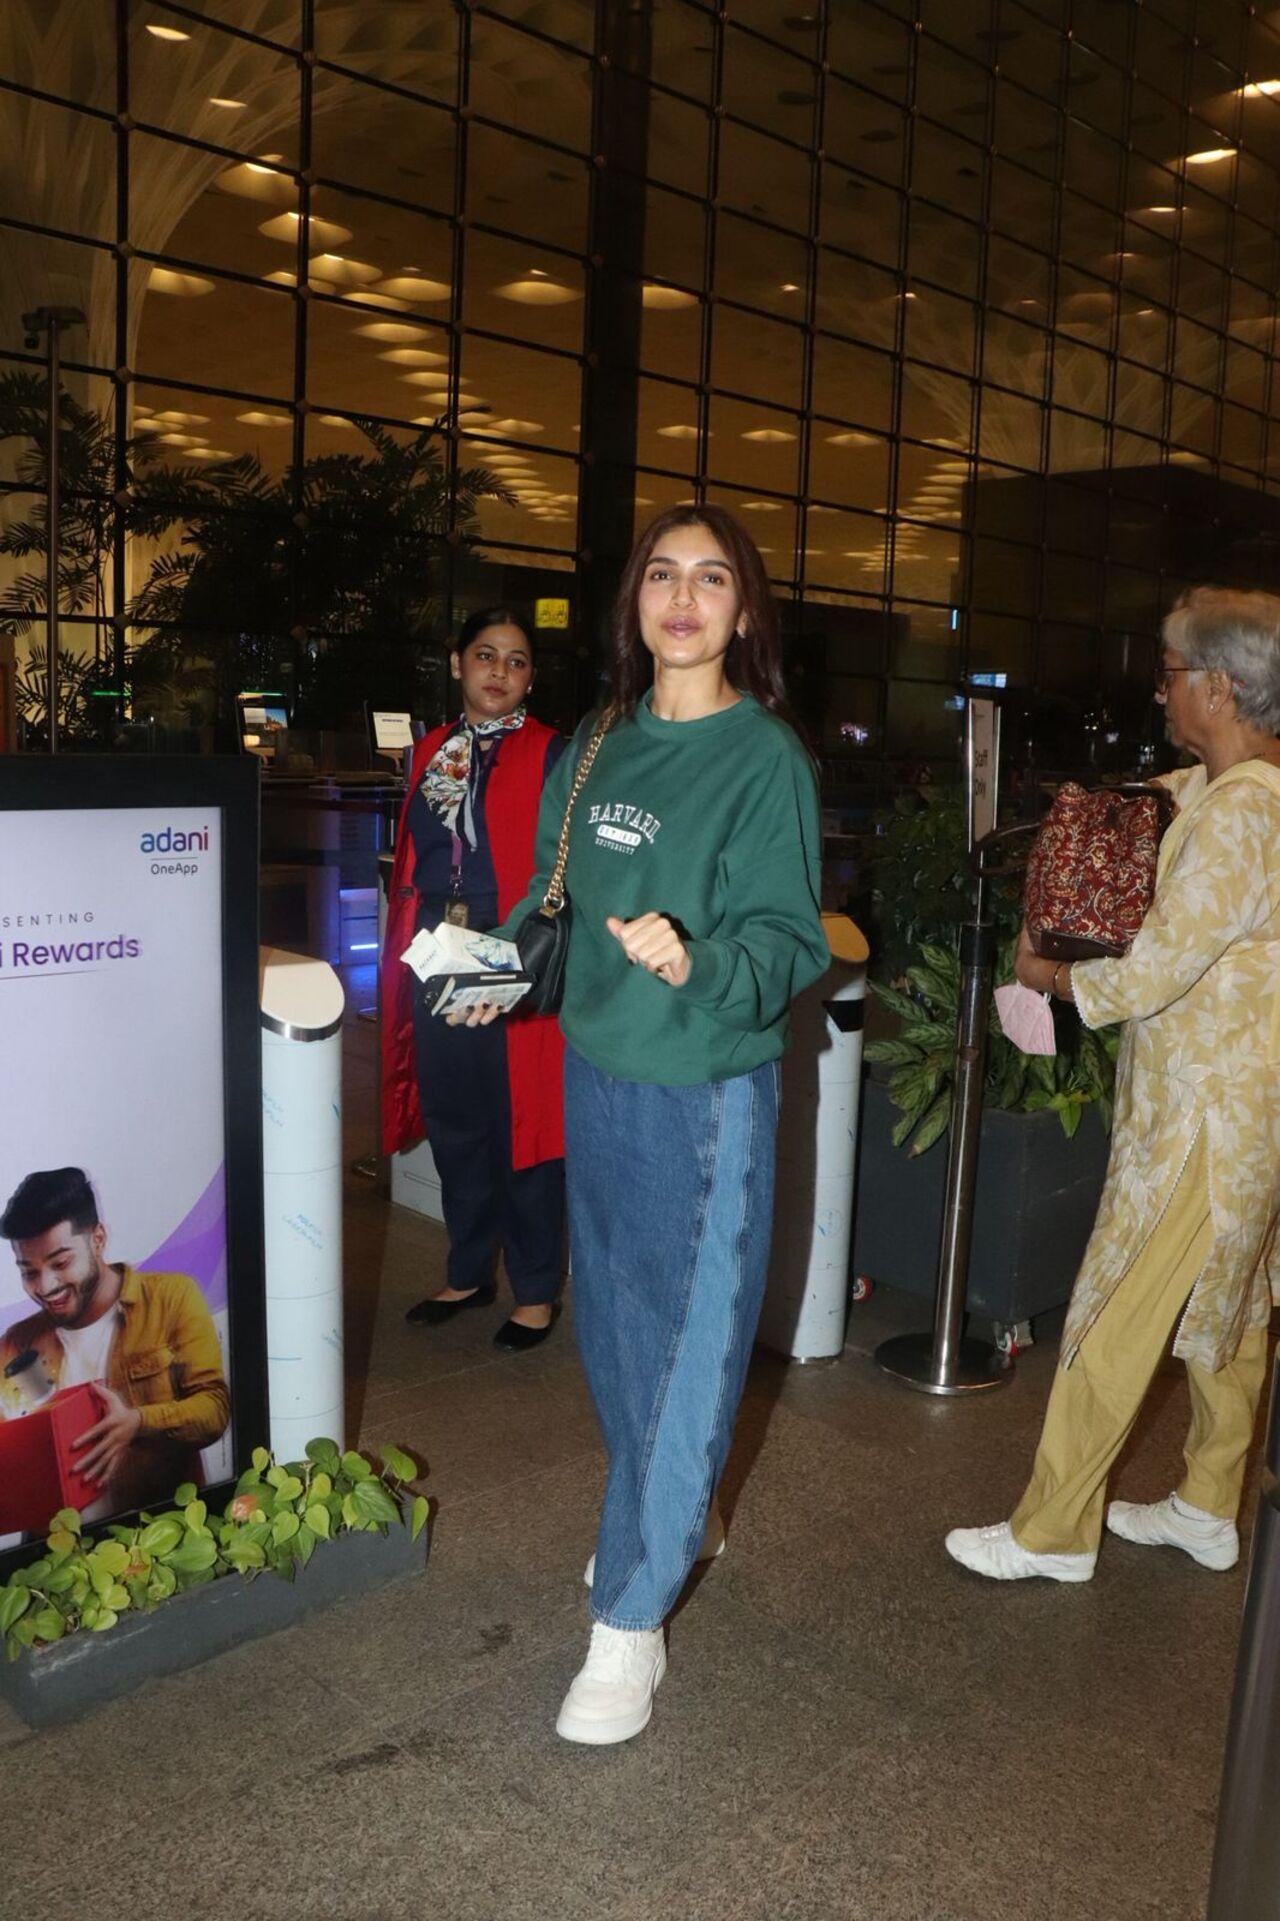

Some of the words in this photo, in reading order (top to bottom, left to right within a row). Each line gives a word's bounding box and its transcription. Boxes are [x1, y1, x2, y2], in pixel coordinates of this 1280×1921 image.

[588, 802, 661, 840] HARVARD
[140, 826, 209, 854] adani
[150, 862, 198, 876] OneApp
[2, 911, 95, 929] SENTING
[13, 934, 140, 967] Rewards
